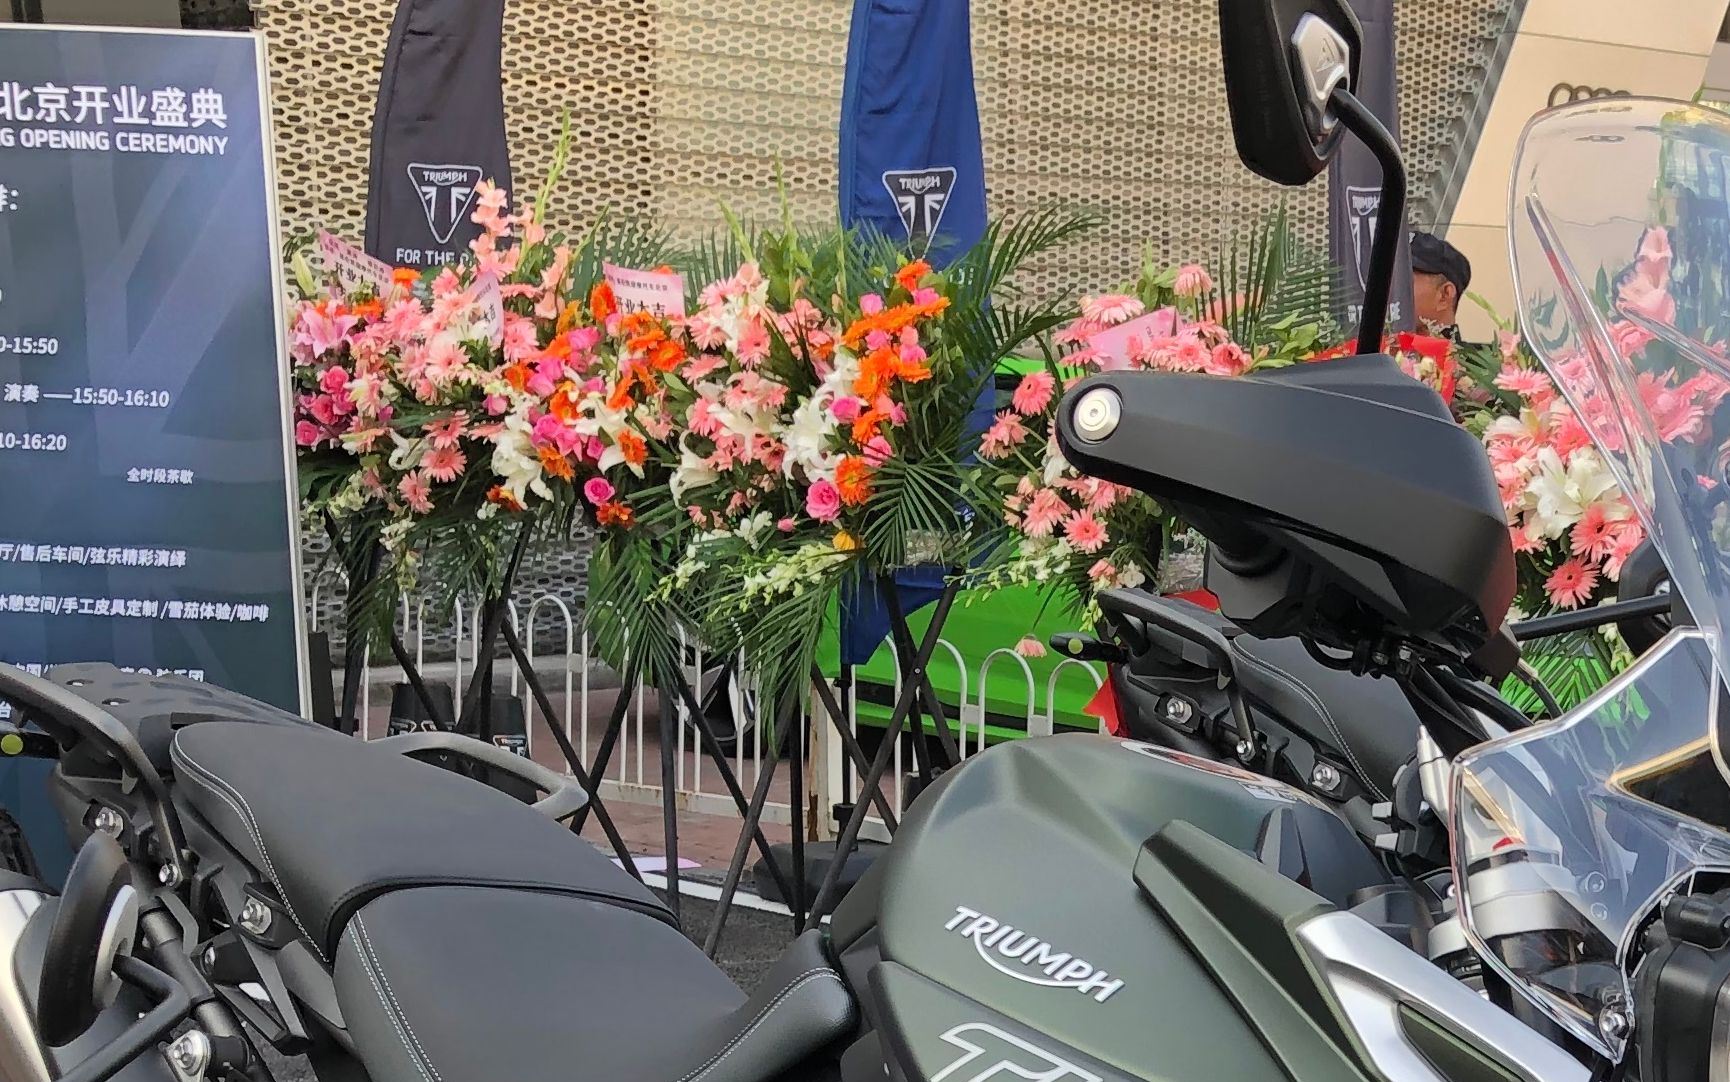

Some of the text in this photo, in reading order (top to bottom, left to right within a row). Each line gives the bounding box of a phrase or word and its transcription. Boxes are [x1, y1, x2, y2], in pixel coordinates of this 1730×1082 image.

[20, 128, 110, 151] OPENING
[115, 131, 229, 156] CEREMONY
[422, 171, 467, 185] TRIUMPH
[396, 247, 421, 264] FOR
[4, 383, 40, 403] 演奏
[127, 467, 195, 485] 全时段茶歇
[944, 905, 1125, 1003] TRIUMPH
